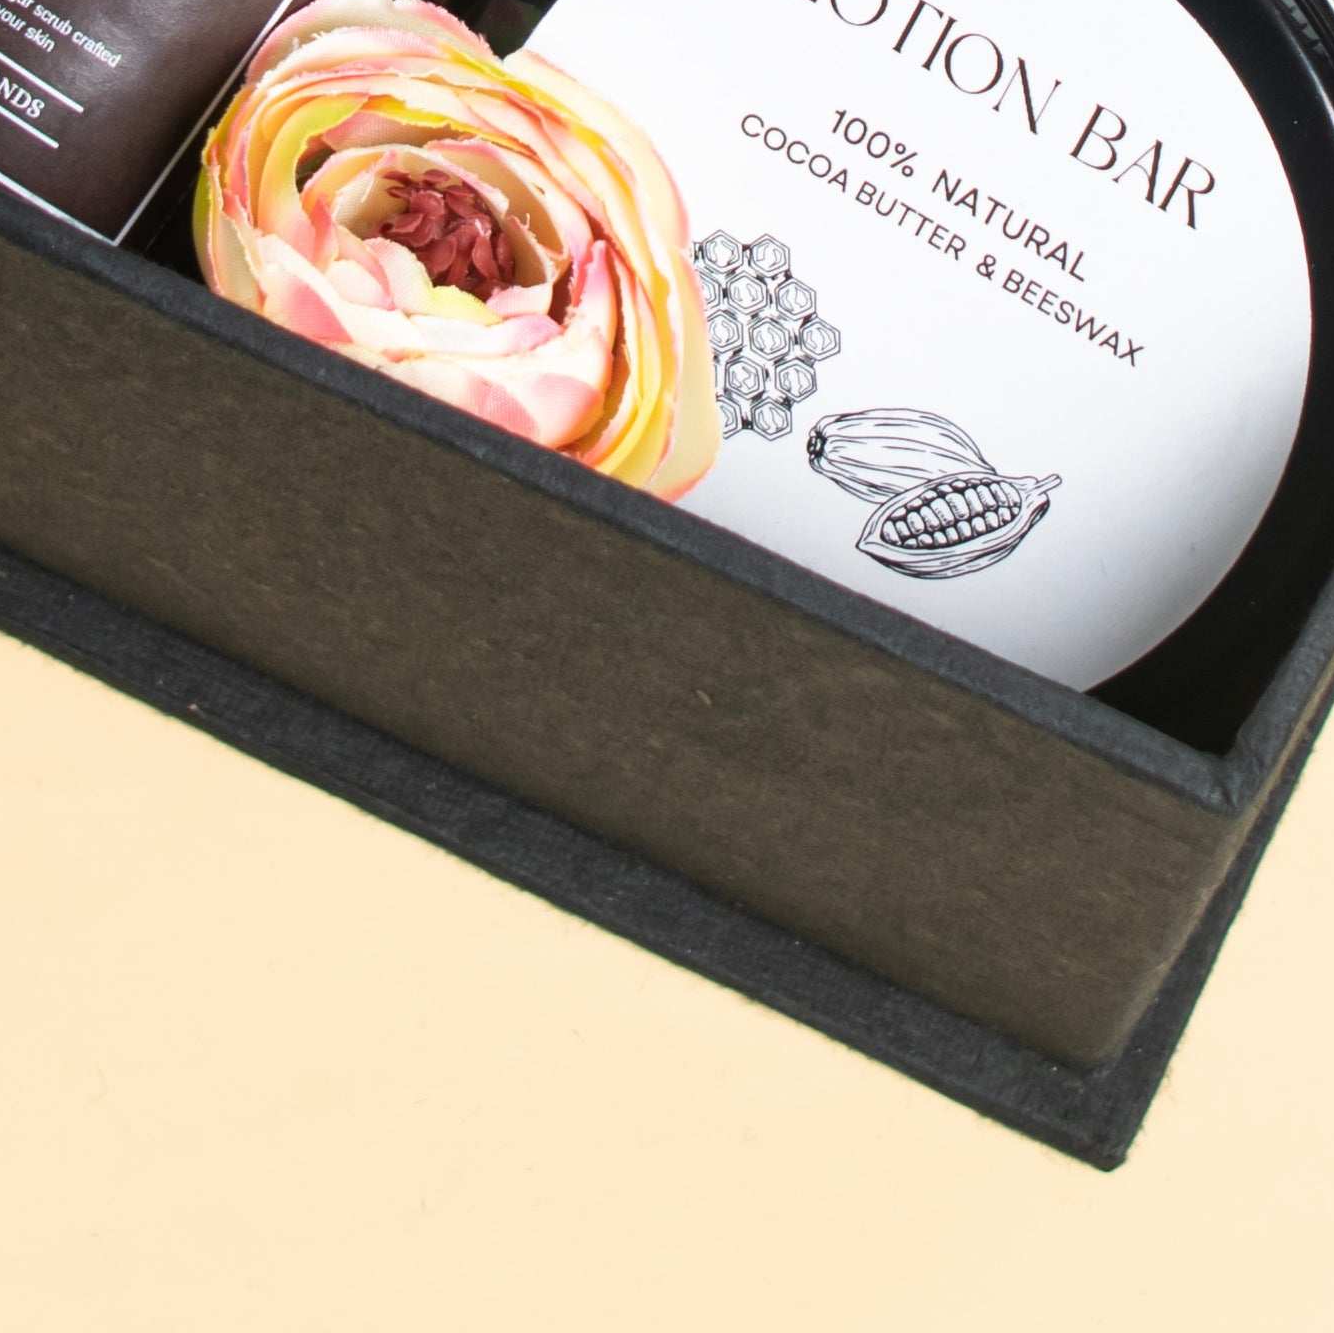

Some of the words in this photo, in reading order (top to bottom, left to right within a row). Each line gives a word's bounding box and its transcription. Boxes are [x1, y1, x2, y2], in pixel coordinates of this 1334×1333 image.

[23, 23, 58, 54] skin
[32, 0, 74, 38] scrub
[70, 24, 123, 70] crafted
[829, 107, 920, 180] 100%
[931, 167, 1089, 284] NATURAL
[1069, 102, 1217, 231] BAR
[739, 111, 850, 195] COCOA
[853, 179, 968, 262] BUTTER
[1002, 267, 1146, 369] BEESWAX
